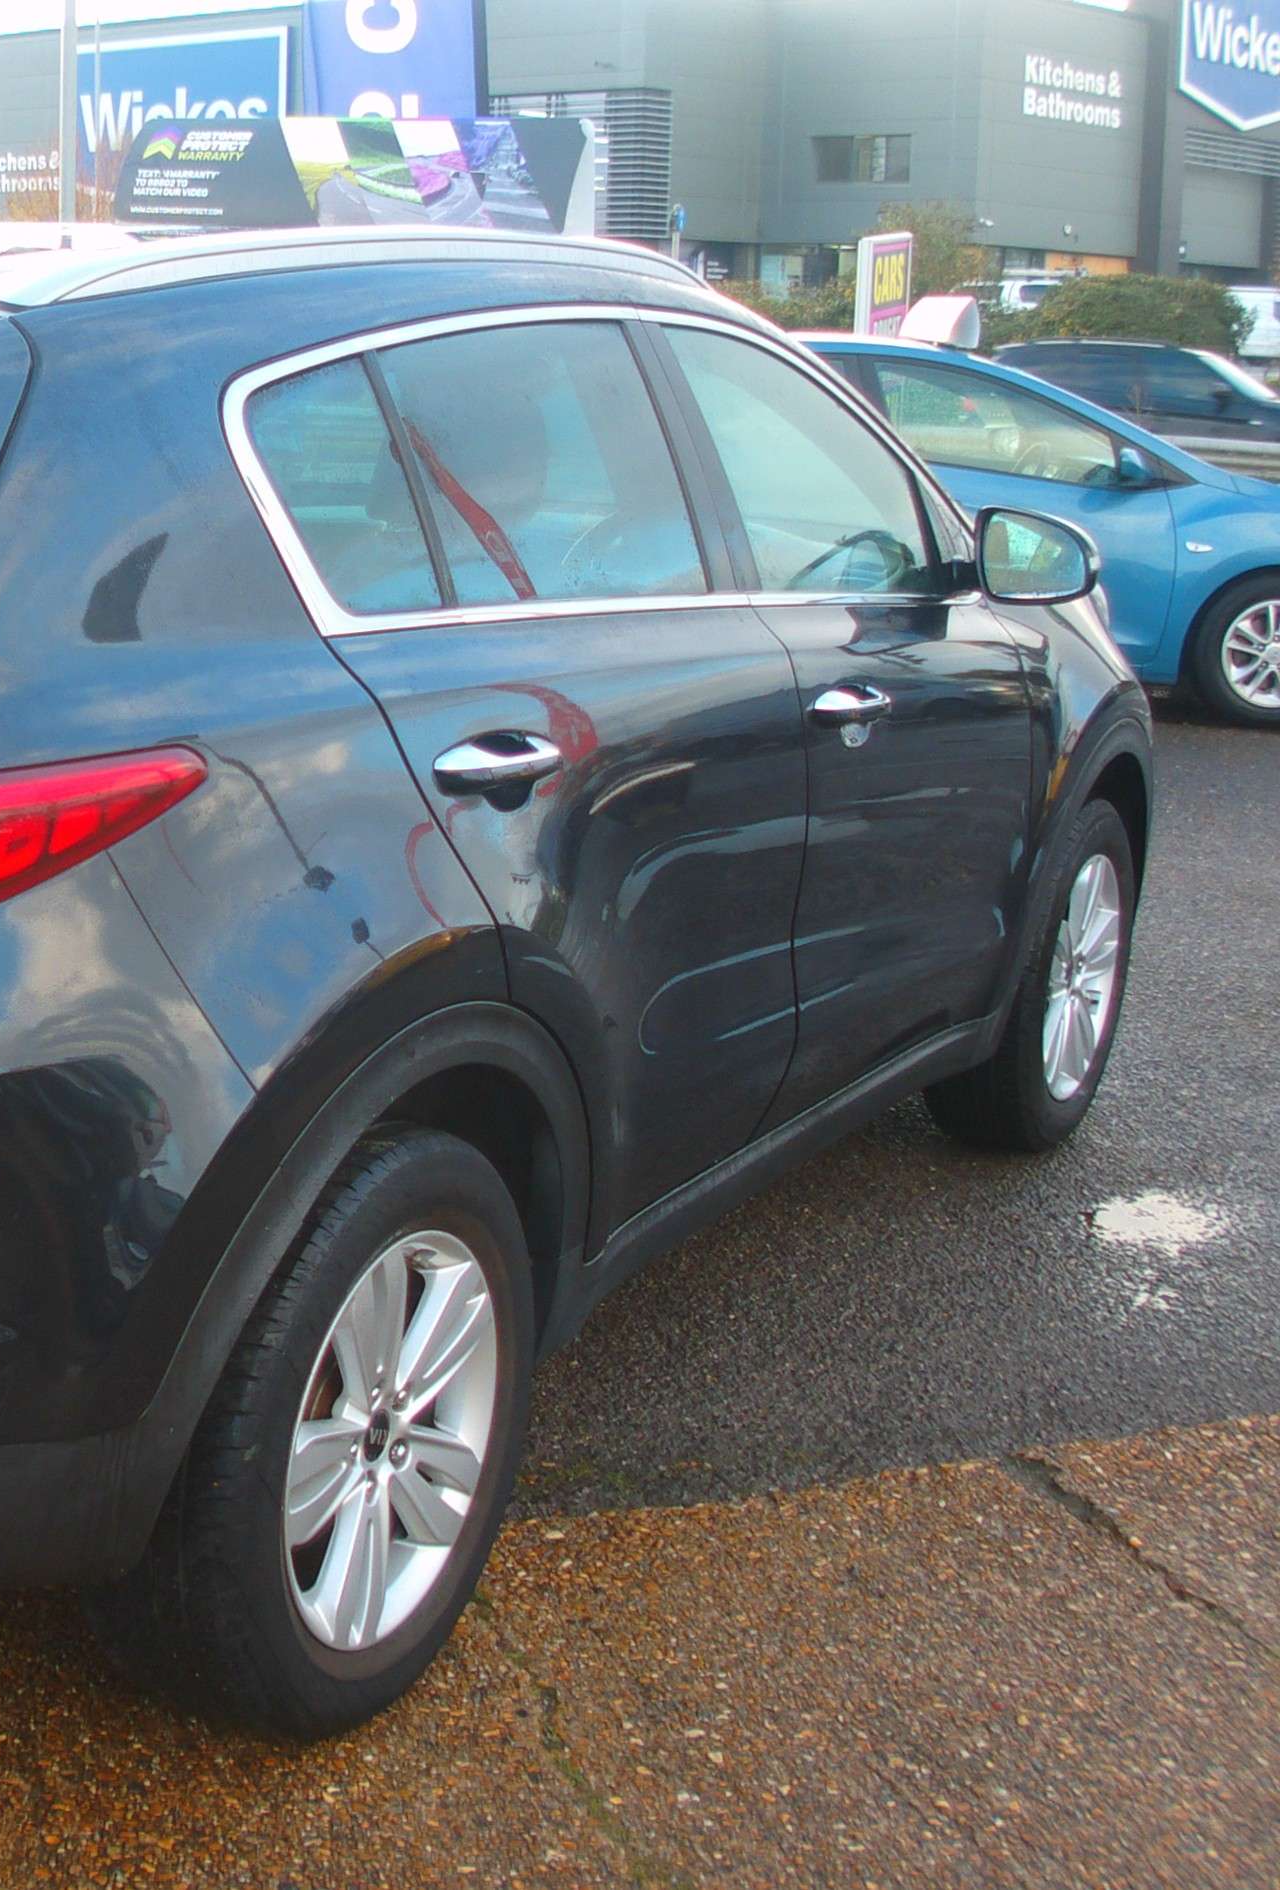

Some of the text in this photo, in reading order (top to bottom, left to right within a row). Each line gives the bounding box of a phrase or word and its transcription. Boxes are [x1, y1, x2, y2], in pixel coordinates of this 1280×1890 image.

[1024, 54, 1122, 98] Kitchens &
[1023, 87, 1121, 129] Bathrooms
[186, 131, 253, 142] CUSTOMER
[180, 141, 250, 151] PROTECT
[178, 151, 244, 161] WARRANTY
[183, 188, 209, 198] VIDEO
[874, 253, 905, 305] CARS
